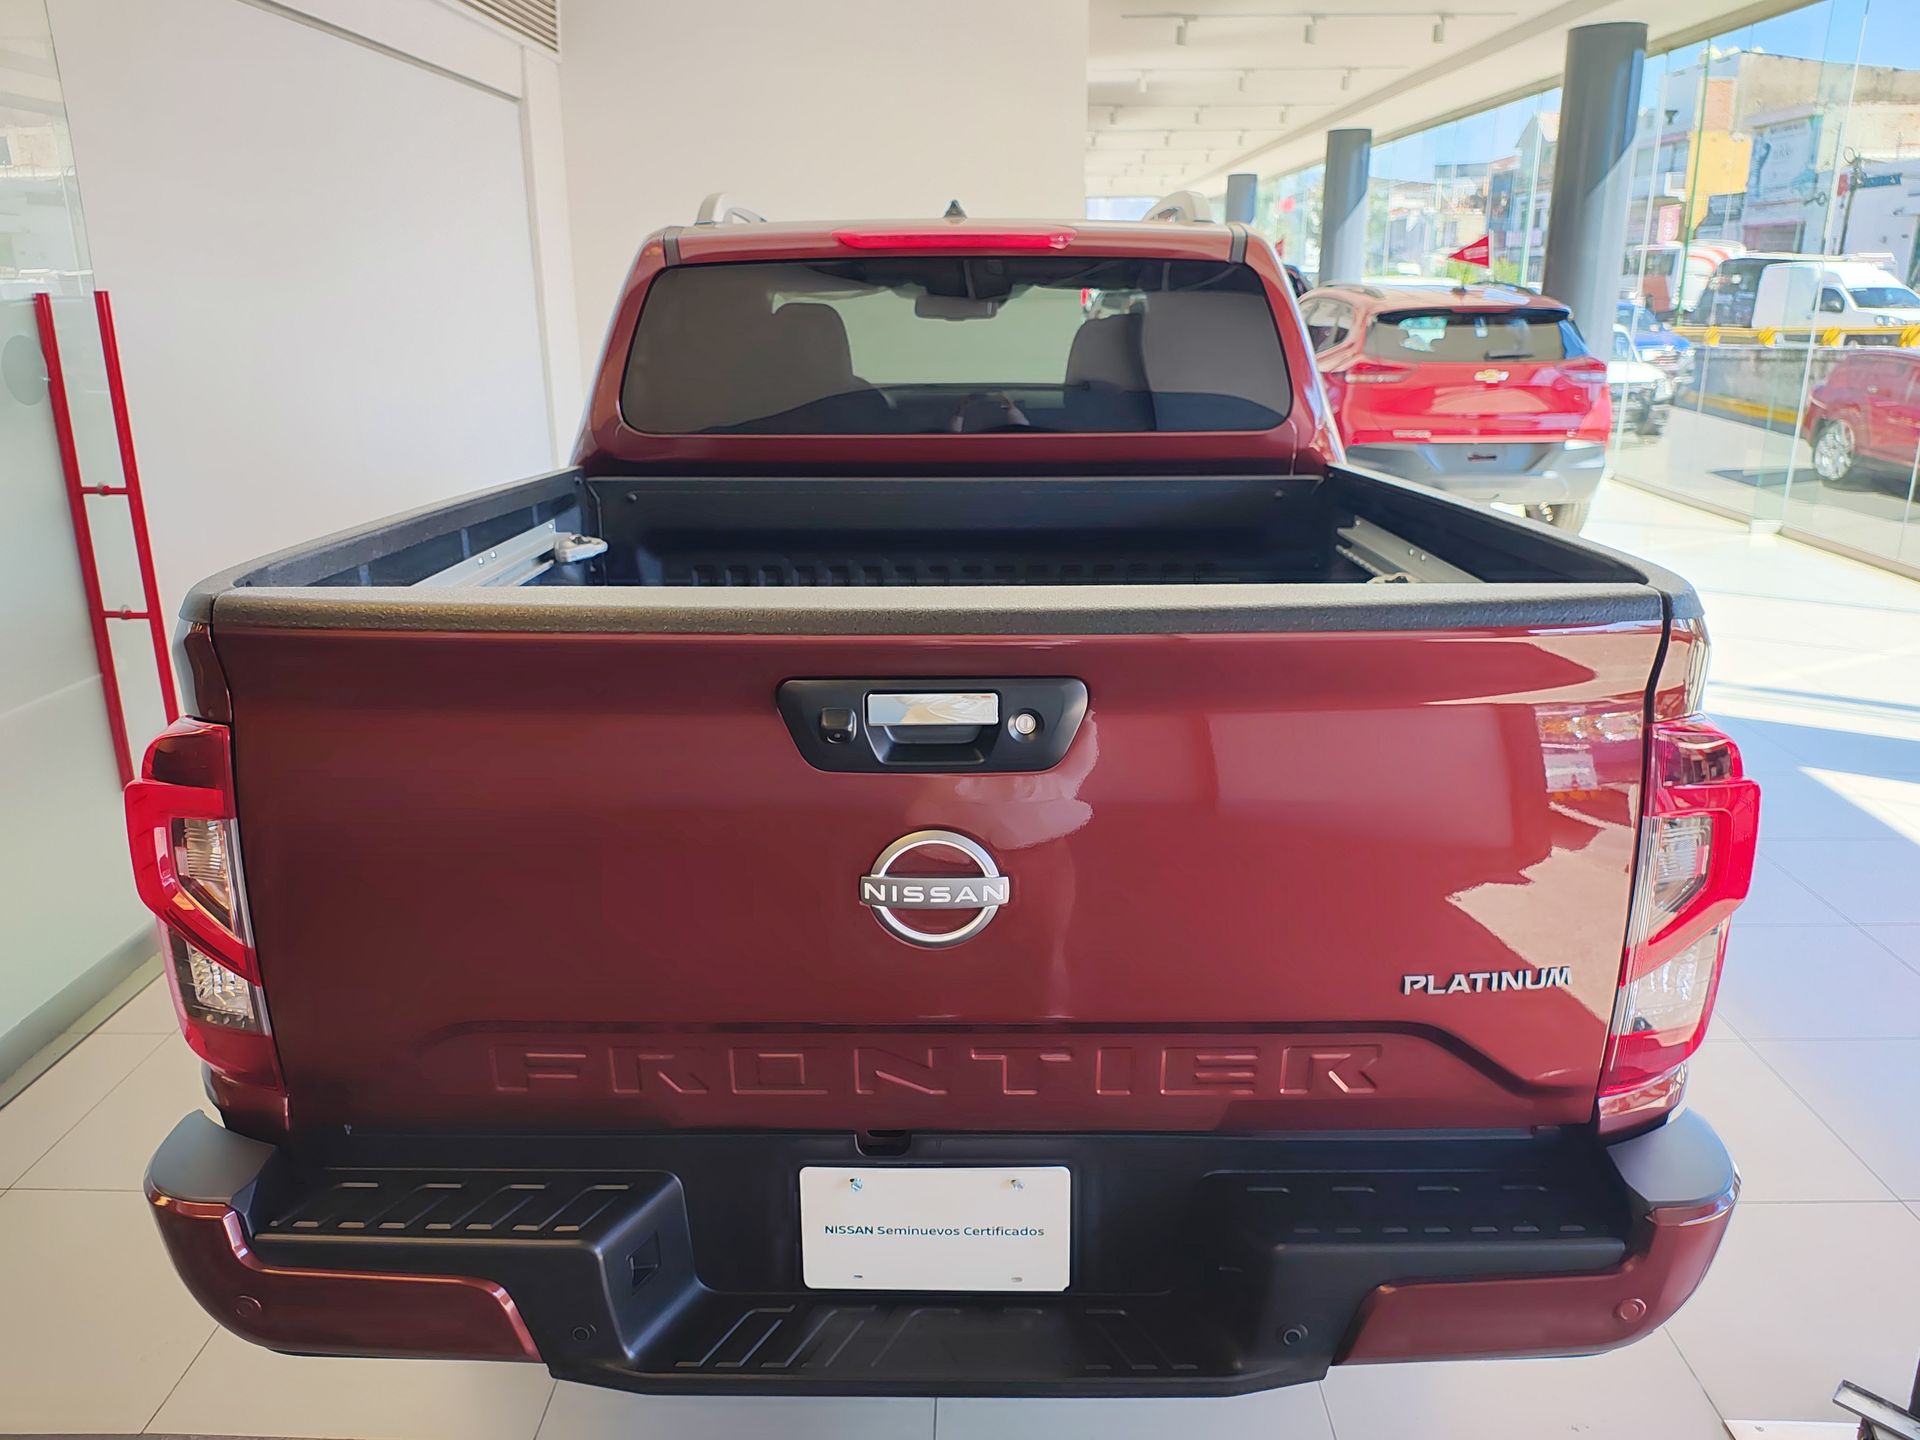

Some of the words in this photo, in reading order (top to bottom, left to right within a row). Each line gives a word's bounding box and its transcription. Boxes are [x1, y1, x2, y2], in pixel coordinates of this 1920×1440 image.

[863, 882, 1004, 903] NISSAN
[1402, 966, 1573, 996] PLATINUM
[488, 1044, 1384, 1096] FRONTIER
[824, 1224, 874, 1236] NISSAN
[876, 1224, 961, 1237] Seminuevos
[963, 1225, 1046, 1238] Certificados
